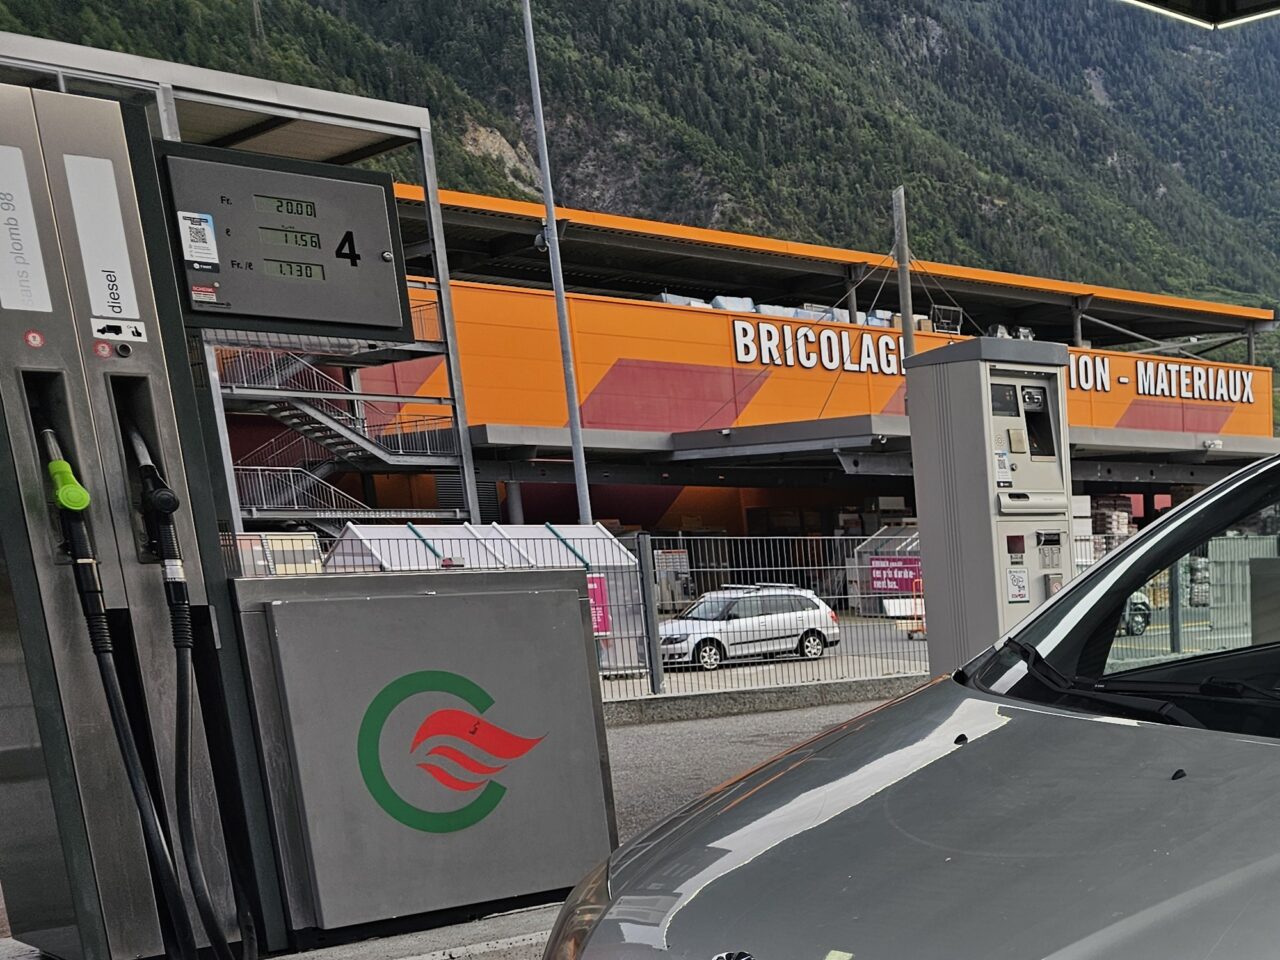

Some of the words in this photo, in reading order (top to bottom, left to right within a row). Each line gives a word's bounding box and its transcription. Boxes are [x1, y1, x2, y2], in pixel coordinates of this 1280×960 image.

[0, 192, 16, 212] 98
[276, 199, 313, 217] 20.00
[4, 217, 31, 266] plomb
[335, 230, 361, 267] 4
[101, 269, 123, 314] diesel
[1136, 360, 1255, 404] MATERIAUX
